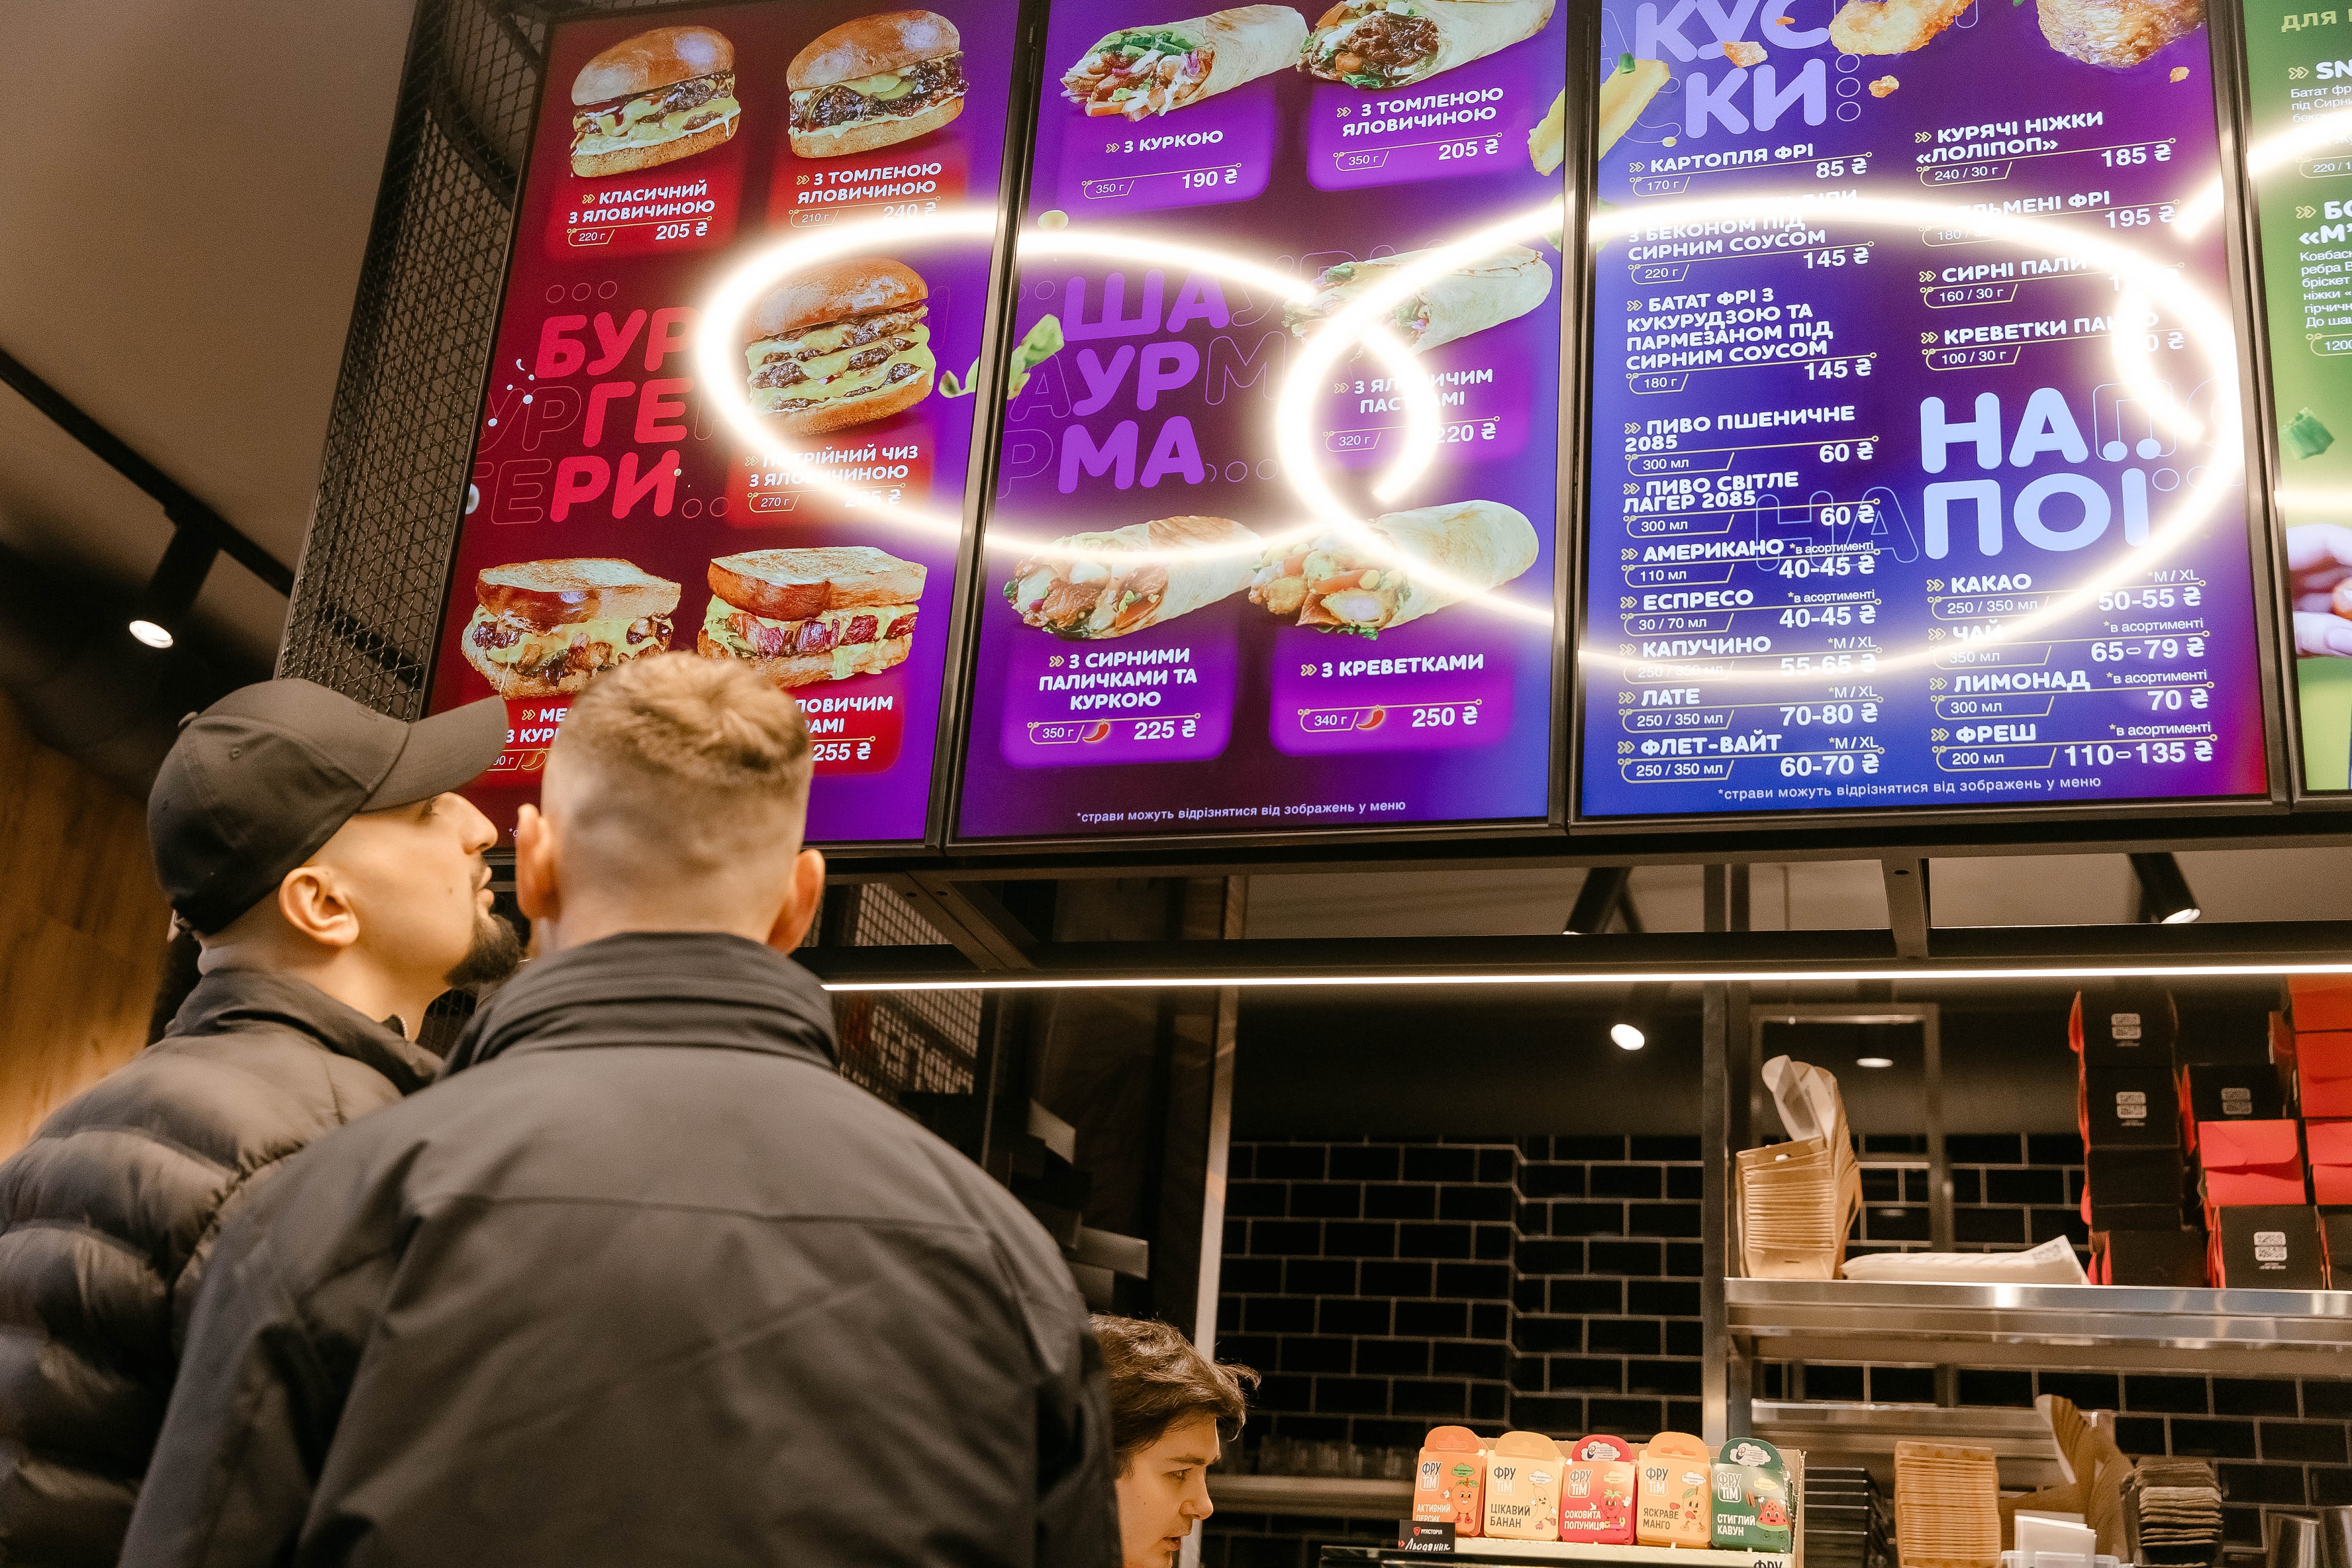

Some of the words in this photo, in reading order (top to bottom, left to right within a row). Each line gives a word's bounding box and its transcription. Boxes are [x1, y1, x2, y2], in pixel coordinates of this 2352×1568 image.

[1636, 0, 1830, 62] КУС
[2281, 11, 2336, 32] для
[1361, 103, 1372, 116] З
[1377, 88, 1504, 113] ТОМЛЕНОЮ
[1686, 58, 1827, 139] КИ
[2291, 88, 2328, 98] Батат
[2292, 101, 2311, 111] під
[1343, 107, 1496, 137] ЯЛОВИЧИНОЮ
[1937, 121, 2018, 144] КУРЯЧІ
[2025, 111, 2103, 132] НІЖКИ
[1124, 141, 1133, 153] З
[1139, 130, 1223, 151] КУРКОЮ
[1438, 141, 1478, 160] 205
[1916, 137, 2058, 164] «ЛОЛІПОП»
[1651, 148, 1768, 172] КАРТОПЛЯ
[1775, 143, 1813, 158] ФРІ
[2101, 147, 2146, 168] 185
[814, 173, 823, 185] З
[829, 163, 942, 184] ТОМЛЕНОЮ
[1816, 161, 1844, 178] 85
[1095, 184, 1115, 194] 350
[1182, 171, 1218, 189] 190
[1647, 179, 1669, 191] 170
[1672, 179, 1679, 189] г
[599, 180, 707, 205] КЛАСИЧНИЙ
[797, 180, 936, 204] ЯЛОВИЧИНОЮ
[2068, 191, 2109, 208] ФРІ
[568, 213, 577, 224] З
[583, 200, 714, 222] ЯЛОВИЧИНОЮ
[883, 204, 918, 220] 240
[2105, 208, 2151, 229] 195
[579, 231, 597, 242] 220
[656, 223, 690, 240] 205
[1628, 239, 1723, 261] СИРНИМ
[1729, 230, 1825, 251] СОУСОМ
[1803, 250, 1846, 269] 145
[1942, 263, 2013, 283] СИРНІ
[2301, 263, 2341, 277] ребра
[2303, 276, 2350, 289] бріскет
[1064, 268, 1230, 341] ША
[1649, 293, 1711, 312] БАТАТ
[1717, 289, 1756, 306] ФРІ
[1762, 288, 1773, 302] З
[2304, 291, 2340, 300] ніжки
[1627, 306, 1781, 332] КУКУРУДЗОЮ
[1786, 304, 1813, 318] ТА
[2306, 317, 2325, 328] До
[1627, 325, 1782, 352] ПАРМЕЗАНОМ
[1789, 321, 1833, 341] ПІД
[1944, 319, 2066, 344] КРЕВЕТКИ
[535, 306, 701, 378] БУР
[1626, 349, 1723, 370] СИРНИМ
[1729, 340, 1827, 362] СОУСОМ
[1073, 341, 1200, 416] УР
[1805, 361, 1847, 380] 145
[1644, 377, 1667, 388] 180
[1671, 377, 1677, 386] г
[583, 378, 695, 447] ГЕ
[1647, 417, 1711, 435] ПИВО
[1717, 406, 1855, 430] ПШЕНИЧНЕ
[1920, 388, 2088, 473] НА
[1339, 435, 1361, 446] 320
[1364, 436, 1370, 444] г
[1625, 435, 1678, 452] 2085
[882, 445, 918, 460] ЧИЗ
[1058, 416, 1204, 494] МА
[1819, 444, 1849, 463] 60
[550, 450, 680, 522] РИ
[1646, 477, 1710, 495] ПИВО
[1717, 472, 1799, 490] СВІТЛЕ
[1623, 495, 1695, 514] ЛАГЕР
[1702, 490, 1756, 508] 2085
[1820, 507, 1850, 526] 60
[1643, 539, 1784, 562] АМЕРИКАНО
[1805, 541, 1874, 554] асортименті
[1640, 570, 1665, 581] 110
[1668, 570, 1687, 580] мл
[1779, 558, 1850, 579] 40-45
[1951, 573, 2032, 594] КАКАО
[1643, 589, 1754, 611] ЕСПРЕСО
[1804, 589, 1875, 603] асортименті
[2098, 588, 2175, 611] 50-55
[1779, 606, 1851, 628] 40-45
[2122, 618, 2203, 634] асортименті
[1642, 636, 1771, 658] КАПУЧИНО
[1069, 655, 1079, 668] З
[1085, 648, 1190, 668] СИРНИМИ
[1322, 663, 1333, 678] З
[1339, 654, 1484, 676] КРЕВЕТКАМИ
[1780, 655, 1852, 677] 55-65
[1039, 670, 1168, 691] ПАЛИЧКАМИ
[1173, 668, 1197, 684] ТА
[1954, 670, 2091, 692] ЛИМОНАД
[2125, 669, 2207, 685] асортименті
[795, 696, 893, 713] ЛОВИЧИМ
[1070, 691, 1161, 710] КУРКОЮ
[1641, 688, 1700, 707] ЛАТЕ
[1951, 701, 1977, 713] 300
[1982, 701, 2002, 713] мл
[2147, 690, 2182, 710] 70
[1412, 707, 1455, 728] 250
[1780, 705, 1853, 726] 70-80
[1043, 727, 1065, 738] 350
[1134, 721, 1175, 740] 225
[1956, 723, 2036, 742] ФРЕШ
[2127, 721, 2211, 736] асортименті
[811, 743, 851, 761] 255
[1641, 730, 1782, 756] ФЛЕТ-ВАЙТ
[1780, 756, 1854, 777] 60-70
[1952, 752, 1978, 765] 200
[1984, 753, 2004, 764] мл
[1128, 810, 1174, 822] можуть
[1179, 806, 1257, 819] відрізнятися
[1261, 805, 1280, 816] від
[1284, 803, 1354, 815] зображень
[1359, 804, 1366, 814] у
[1371, 800, 1406, 810] меню
[1422, 1462, 1441, 1475] ФРУ
[1494, 1467, 1516, 1480] ФРУ
[1570, 1470, 1592, 1483] ФРУ
[1645, 1468, 1668, 1481] ФРУ
[1717, 1473, 1741, 1488] ФРУ
[1417, 1503, 1450, 1513] АКТИВНИЙ
[1491, 1504, 1530, 1516] ЦІКАВИЙ
[1565, 1510, 1601, 1519] СОКОВИТА
[1643, 1508, 1679, 1519] ЯСКРАВЕ
[1490, 1517, 1521, 1528] БАНАН
[1564, 1521, 1604, 1530] ПОЛУНИЦЯ
[1643, 1519, 1670, 1529] МАНГО
[1717, 1514, 1755, 1525] СТИГЛИЙ
[1717, 1525, 1744, 1536] КАВУН
[1405, 1538, 1450, 1551] Льодяник
